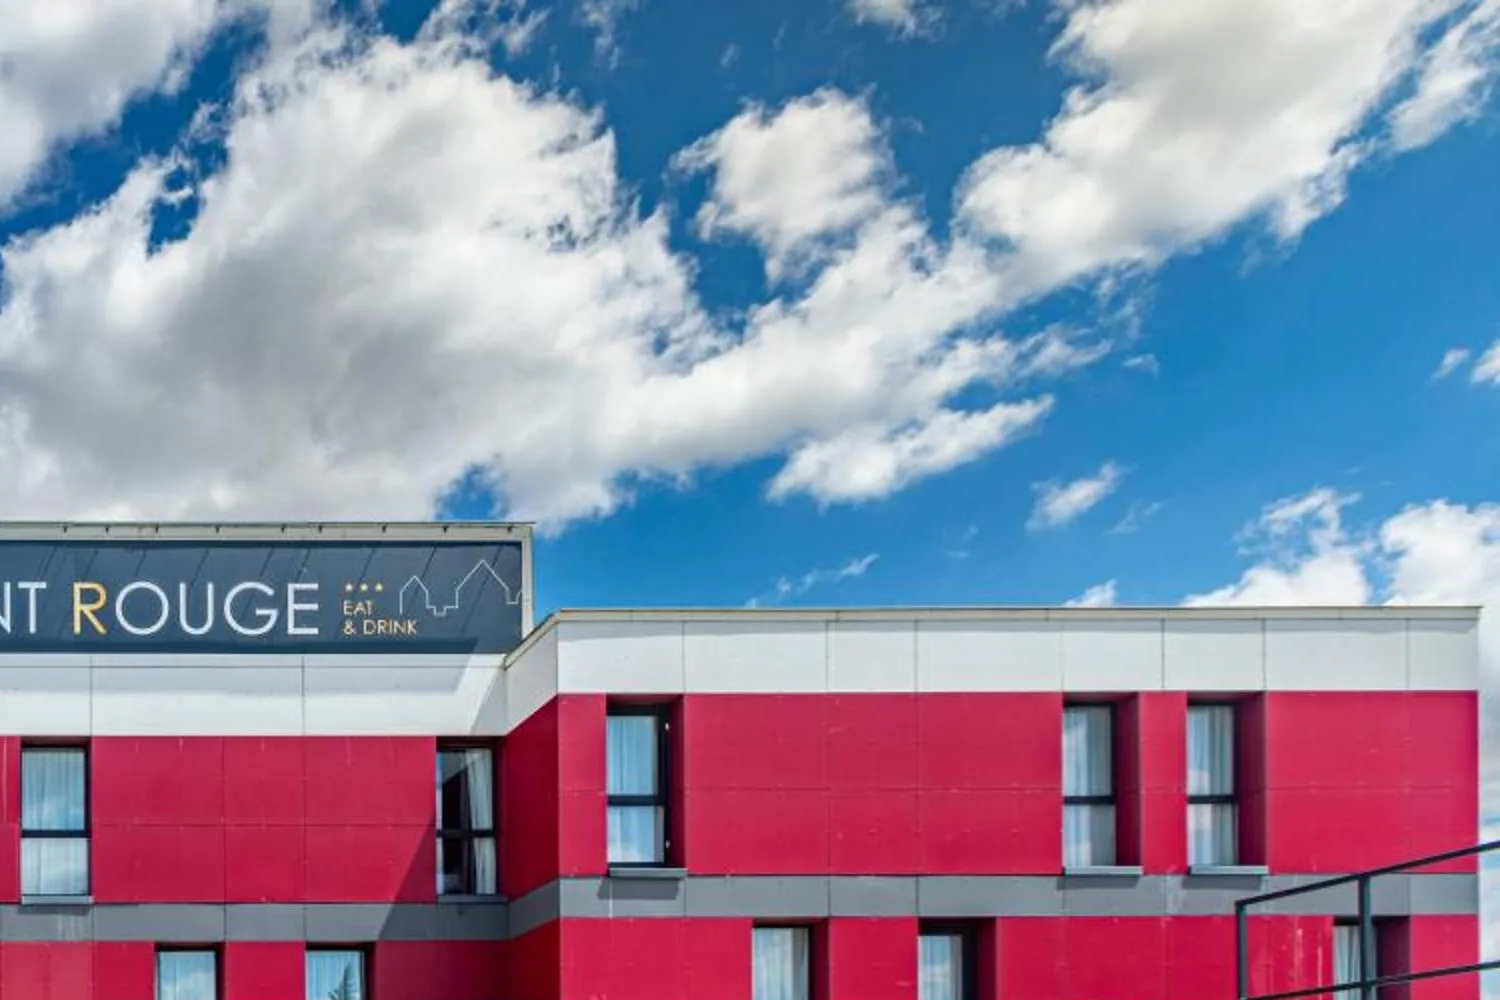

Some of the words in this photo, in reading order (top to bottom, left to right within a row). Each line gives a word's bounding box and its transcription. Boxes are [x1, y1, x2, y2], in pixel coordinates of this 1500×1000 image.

[72, 581, 319, 635] ROUGE
[343, 600, 373, 616] EAT
[343, 619, 356, 636] &
[363, 619, 417, 635] DRINK
